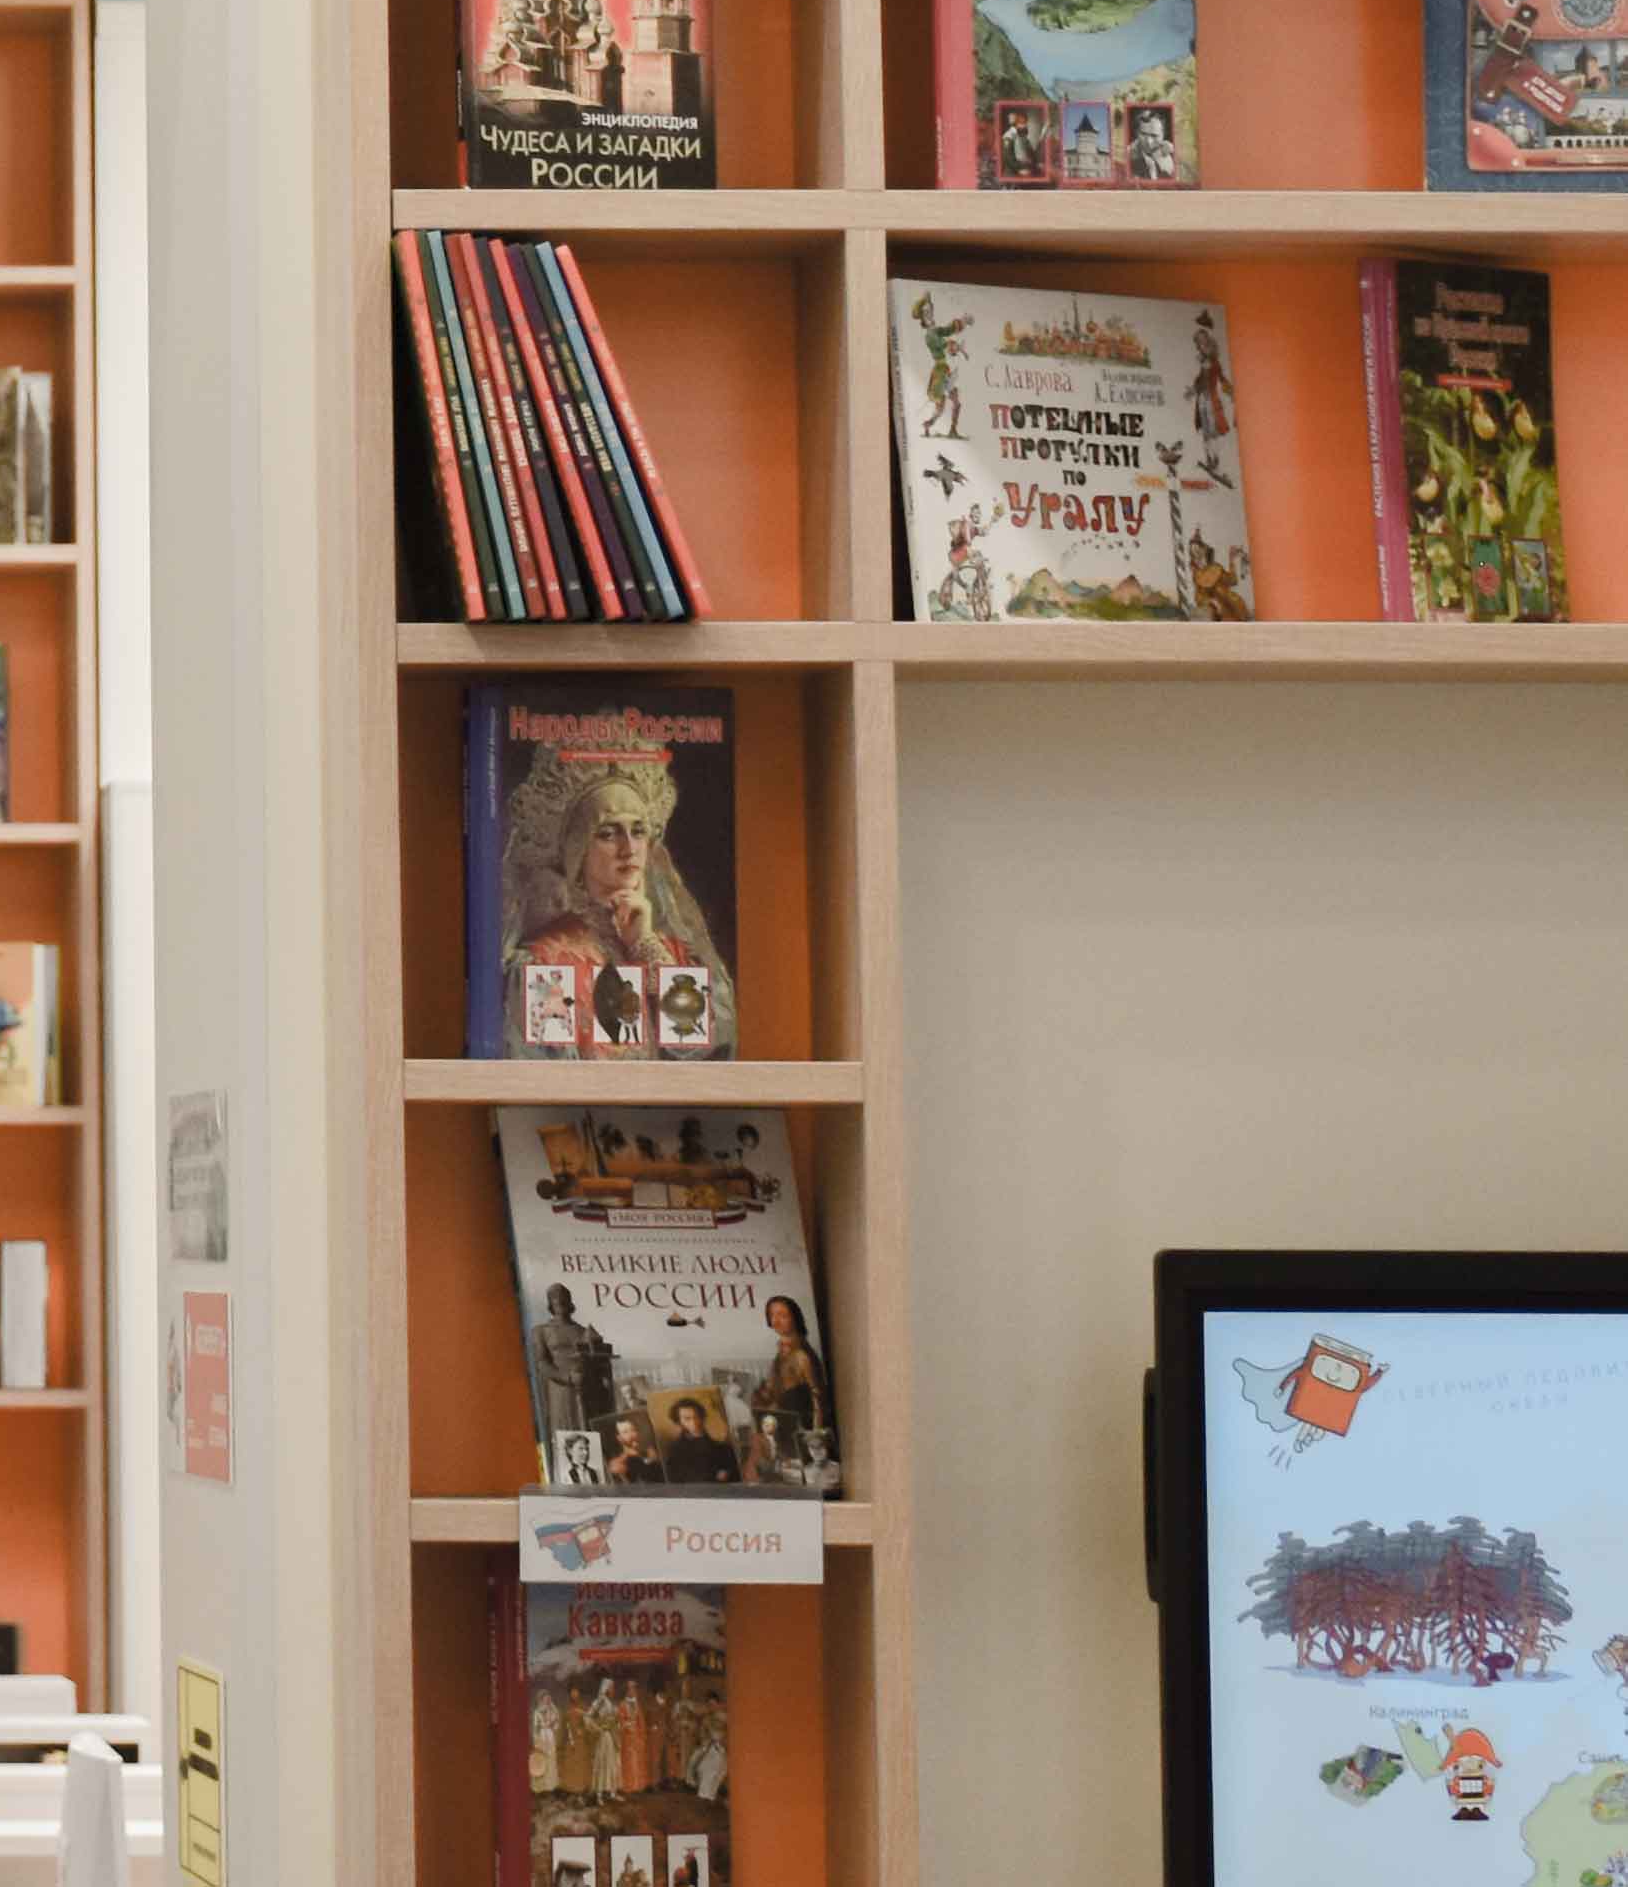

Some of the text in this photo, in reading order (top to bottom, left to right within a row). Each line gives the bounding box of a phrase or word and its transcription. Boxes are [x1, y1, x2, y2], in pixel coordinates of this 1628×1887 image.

[581, 113, 699, 131] ЭНЦИКЛОПЕДИЯ
[480, 125, 702, 162] ЧУДЕСА И ЗАГАДКИ
[530, 158, 659, 189] РОССИИ
[559, 1253, 779, 1276] ВЕЛИКИЕ ЛЮДИ
[592, 1282, 758, 1310] РОССИИ
[666, 1526, 782, 1554] Россия
[566, 1602, 685, 1638] Кавказа
[1369, 1705, 1470, 1721] Калининград
